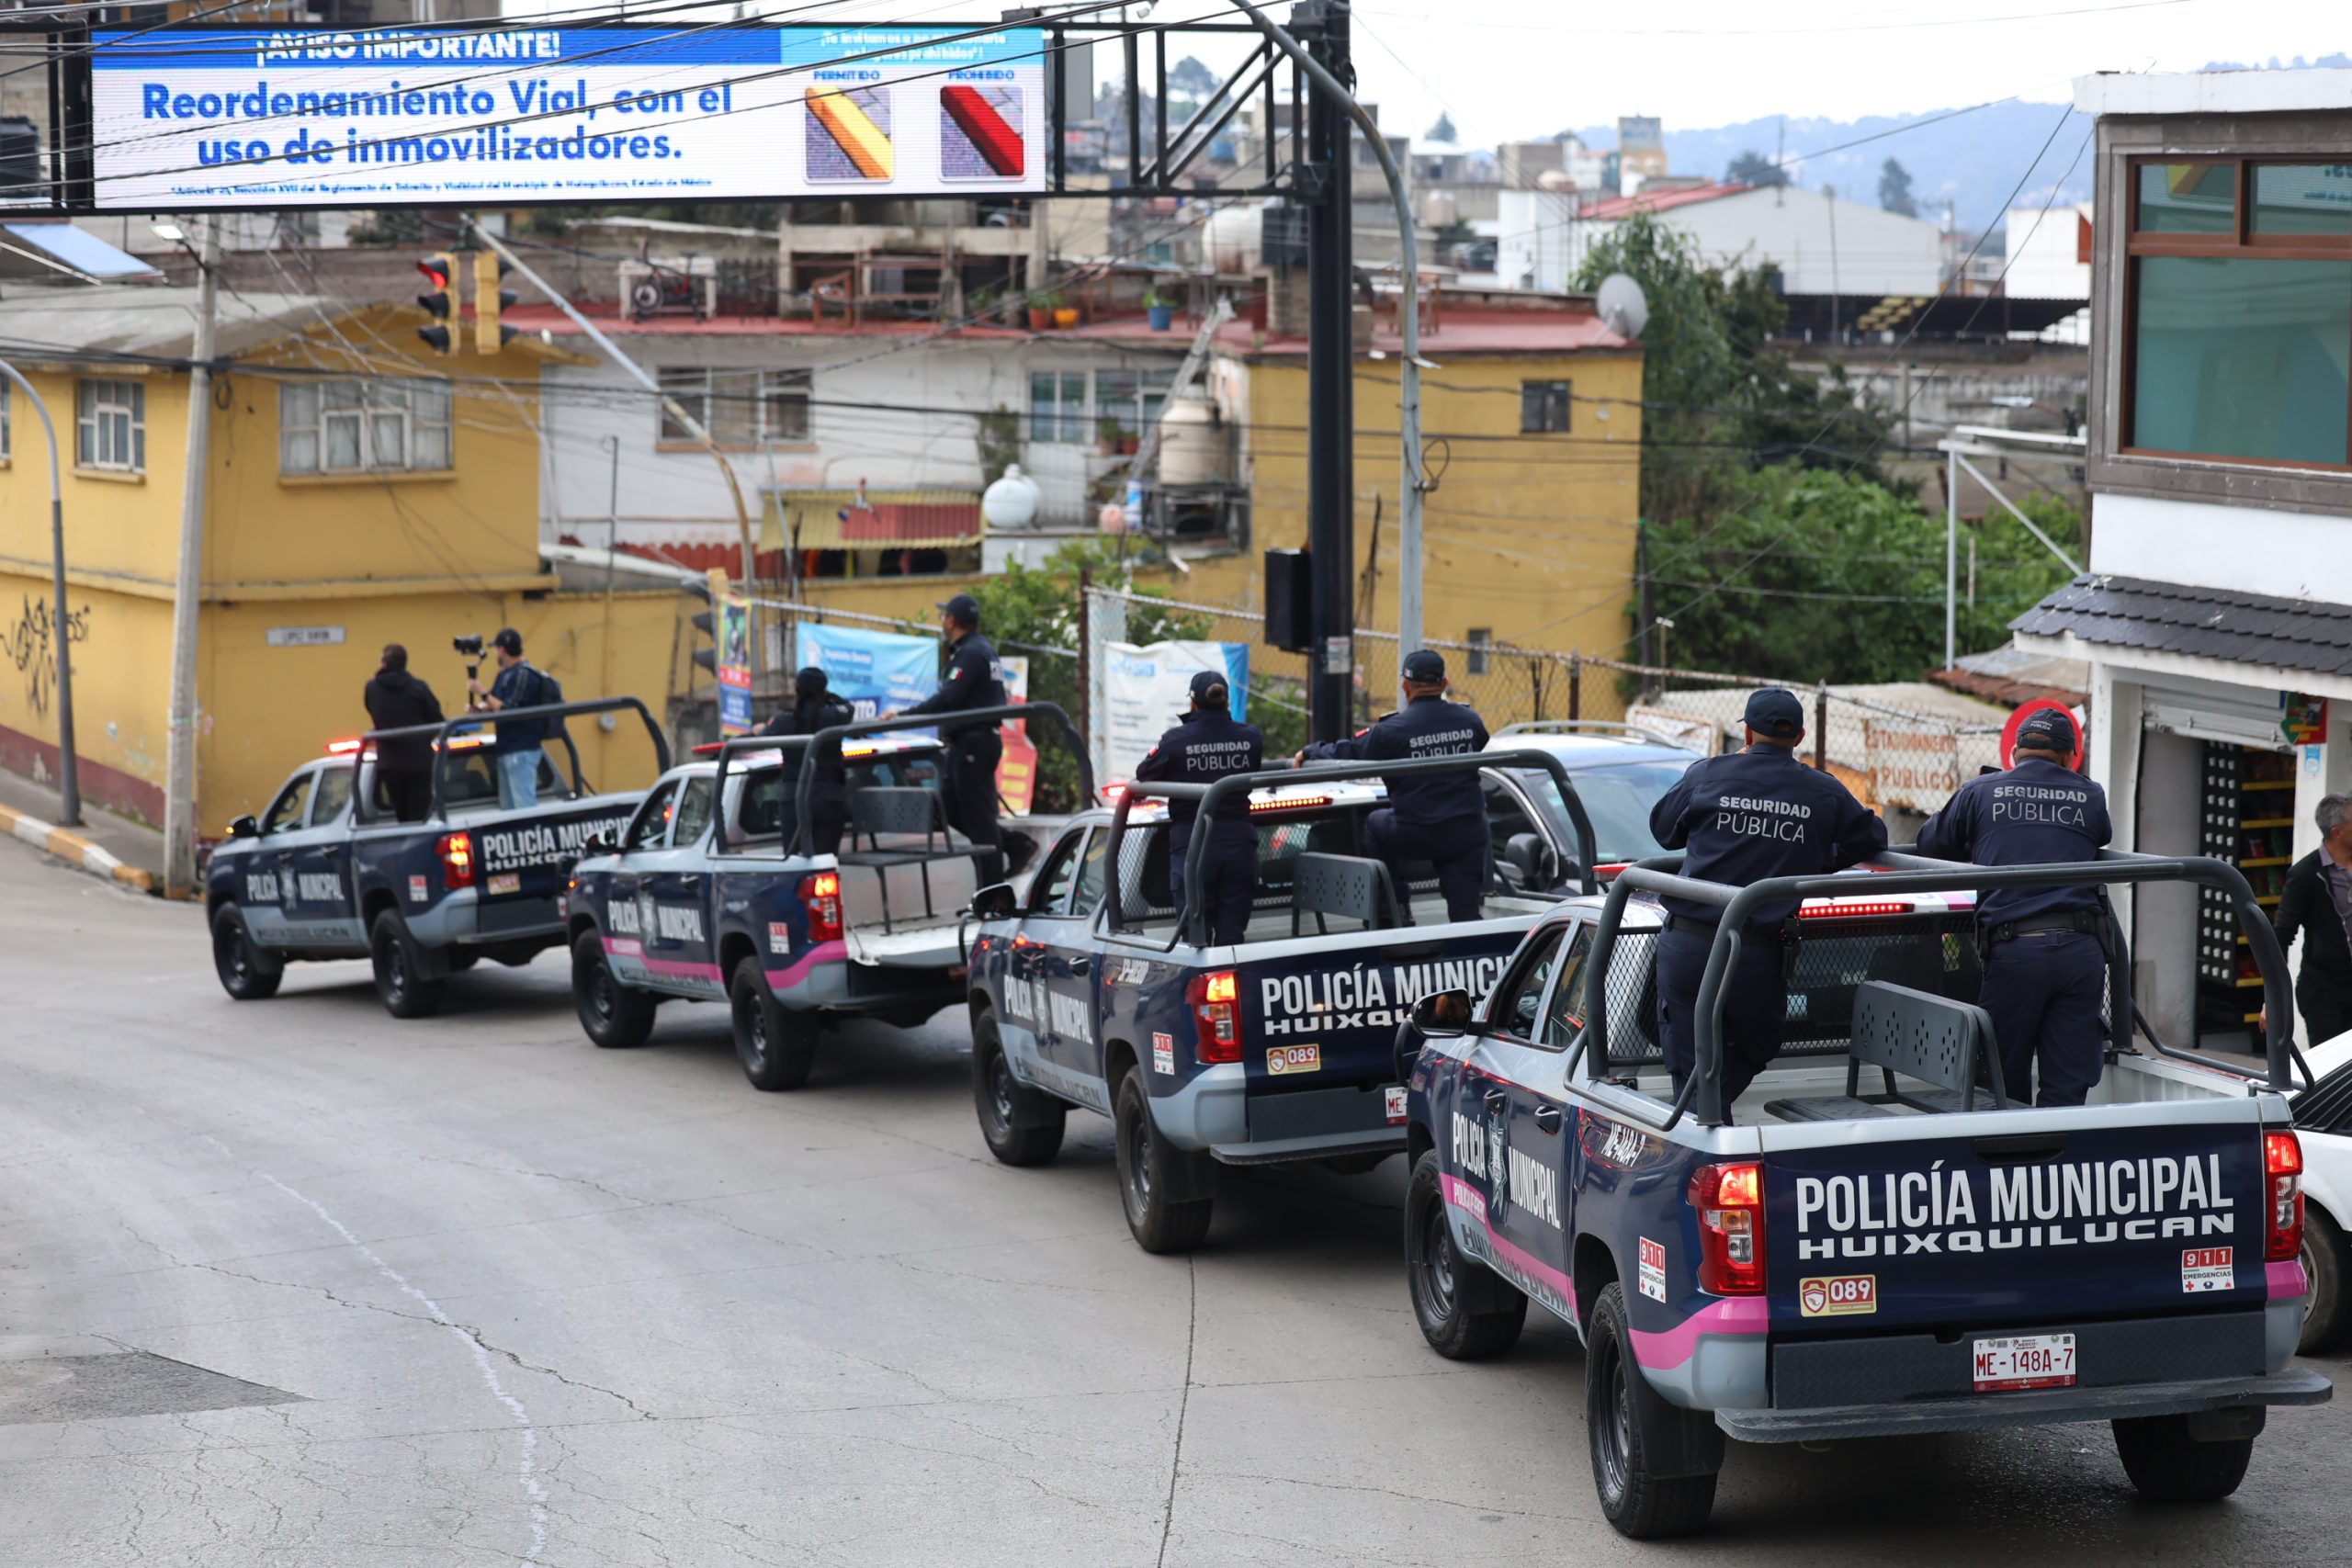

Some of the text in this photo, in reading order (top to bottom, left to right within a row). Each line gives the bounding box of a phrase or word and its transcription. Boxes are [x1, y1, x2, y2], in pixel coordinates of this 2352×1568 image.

[364, 32, 560, 59] IMPORTANTE!
[813, 70, 1015, 80] PERMITIDO PROHIBIDO
[143, 78, 731, 121] Reordenamiento Vial, con el
[198, 125, 682, 165] uso de inmovilizadores.
[1185, 740, 1250, 755] SEGURIDAD
[1408, 728, 1474, 748] SEGURIDAD
[1186, 754, 1250, 772] PÚBLICA
[1881, 766, 1954, 791] PUBLICO
[1719, 795, 1811, 818] SEGURIDAD
[1993, 785, 2087, 804] SEGURIDAD
[1992, 798, 2086, 827] PÚBLICA
[1716, 811, 1804, 844] PÚBLICA
[482, 825, 557, 860] POLICÍA
[246, 868, 279, 901] POLICÍA
[607, 897, 640, 934] POLICÍA
[658, 905, 705, 942] MUNICIPAL
[1003, 973, 1034, 1022] POLICÍA
[1261, 962, 1386, 1017] POLICÍA
[1288, 1047, 1316, 1064] 089
[1453, 1111, 1487, 1181] POLICÍA
[1509, 1145, 1560, 1230] MUNICIPAL
[1796, 1154, 2233, 1234] POLICÍA MUNICIPAL
[1799, 1213, 2233, 1259] HUIXQUILUCAN
[1641, 1243, 1662, 1268] 911
[2187, 1250, 2227, 1267] 911
[1640, 1269, 1665, 1287] EMERGENCIAS
[2183, 1270, 2233, 1280] EMERGENCIAS
[1830, 1279, 1871, 1302] 089
[1976, 1348, 2074, 1377] ME-148A-7
